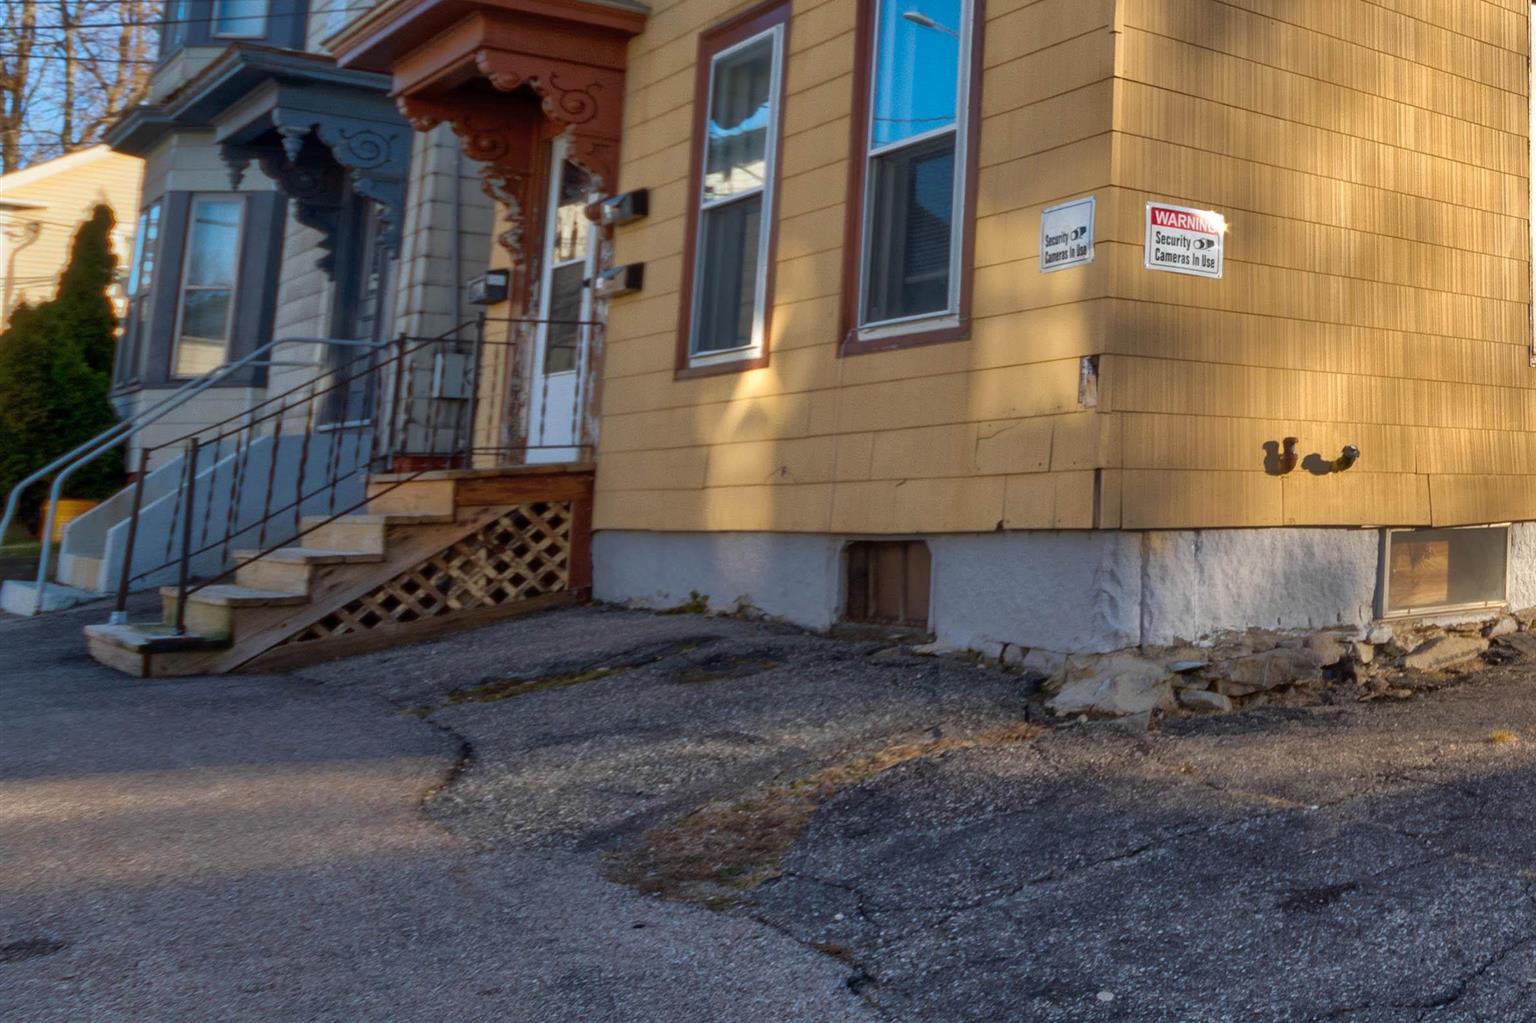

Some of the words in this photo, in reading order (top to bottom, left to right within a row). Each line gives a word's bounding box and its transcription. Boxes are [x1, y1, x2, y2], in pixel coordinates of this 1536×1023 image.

[1045, 233, 1069, 247] Security
[1155, 231, 1191, 251] Security
[1045, 250, 1068, 264] Cameras
[1076, 244, 1087, 257] Use
[1155, 247, 1190, 265] Cameras
[1192, 253, 1200, 267] In
[1201, 254, 1215, 268] Use
